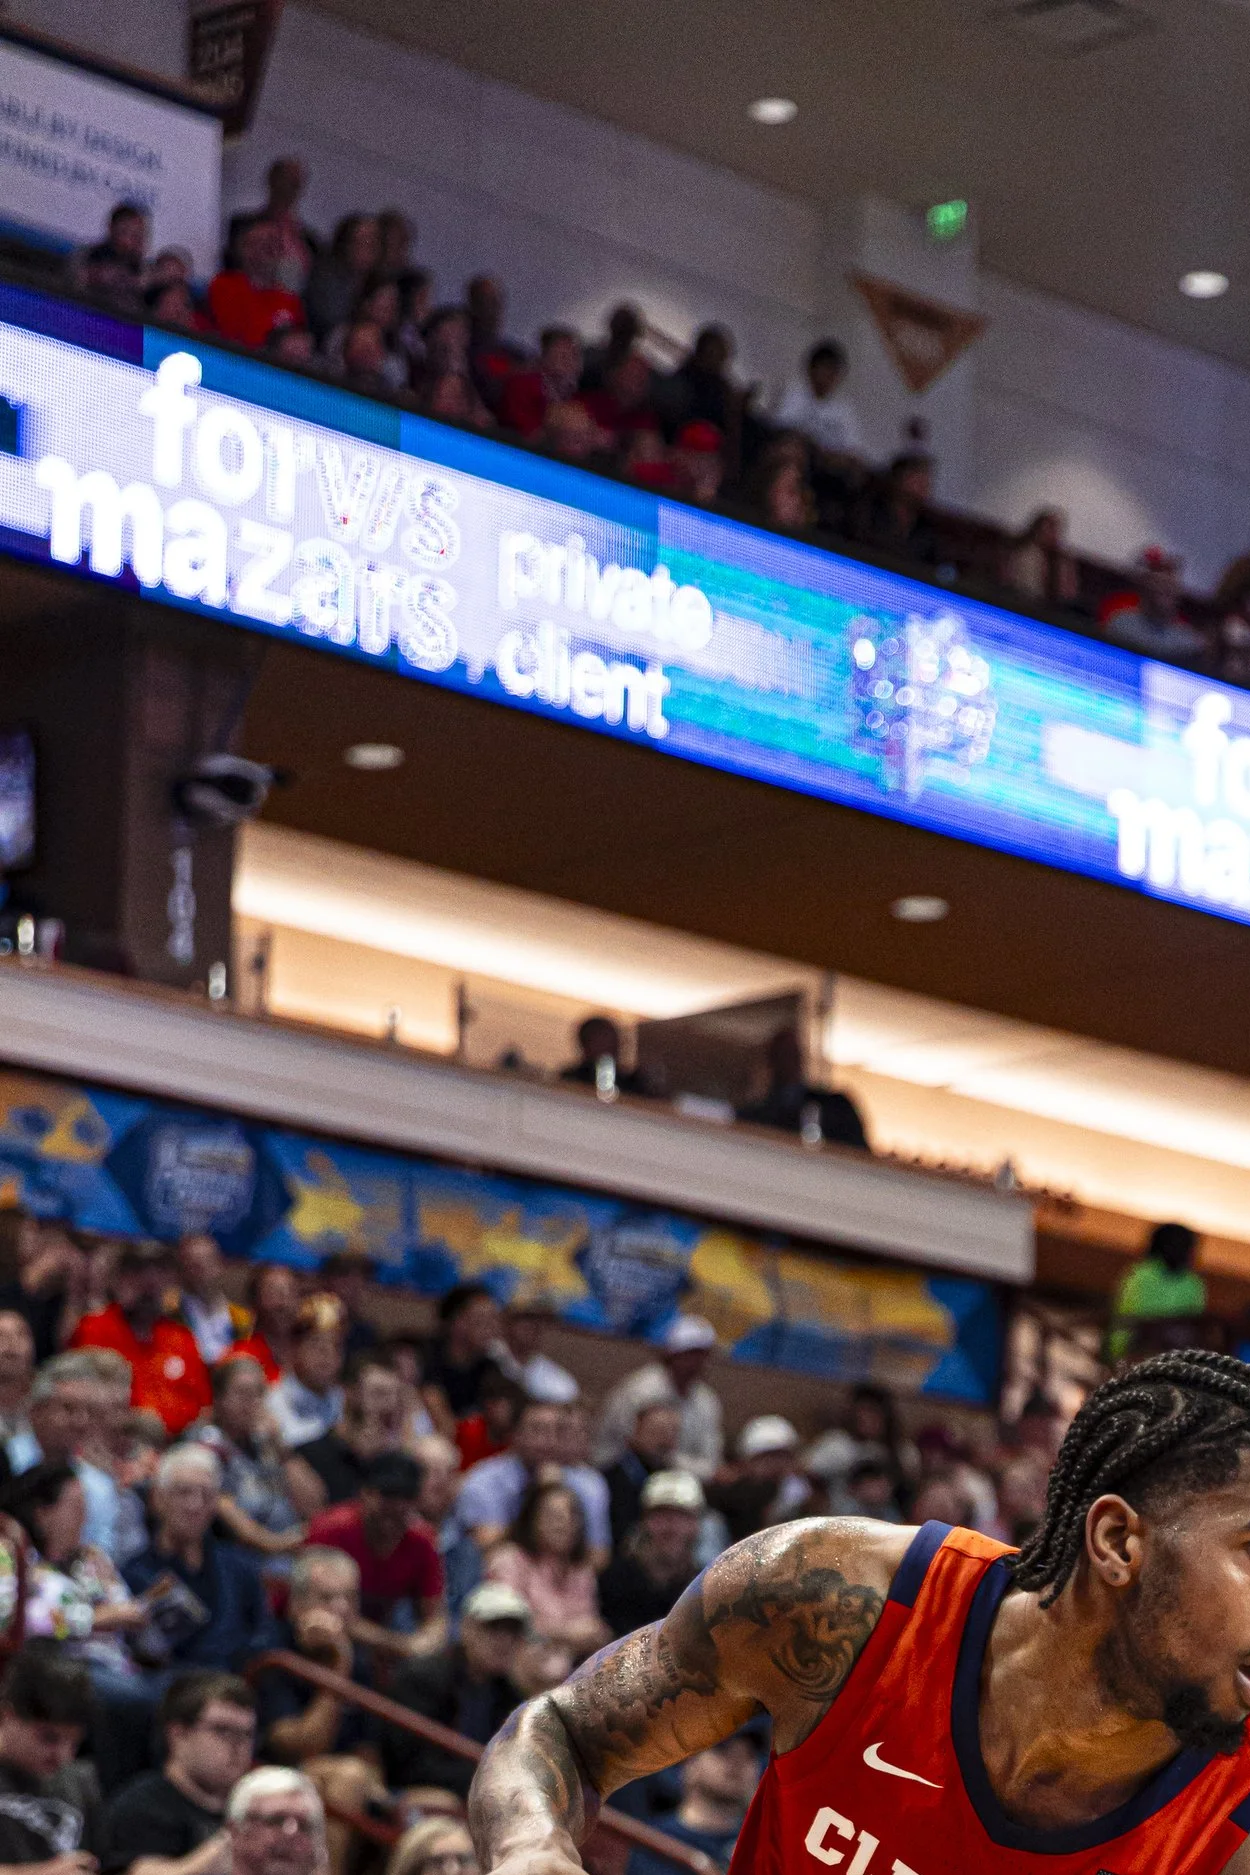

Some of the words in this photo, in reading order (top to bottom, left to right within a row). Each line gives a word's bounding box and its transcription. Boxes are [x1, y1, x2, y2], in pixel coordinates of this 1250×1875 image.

[140, 351, 461, 570] forvis
[36, 456, 459, 673] mazars
[499, 530, 714, 650] private
[496, 619, 671, 739] client
